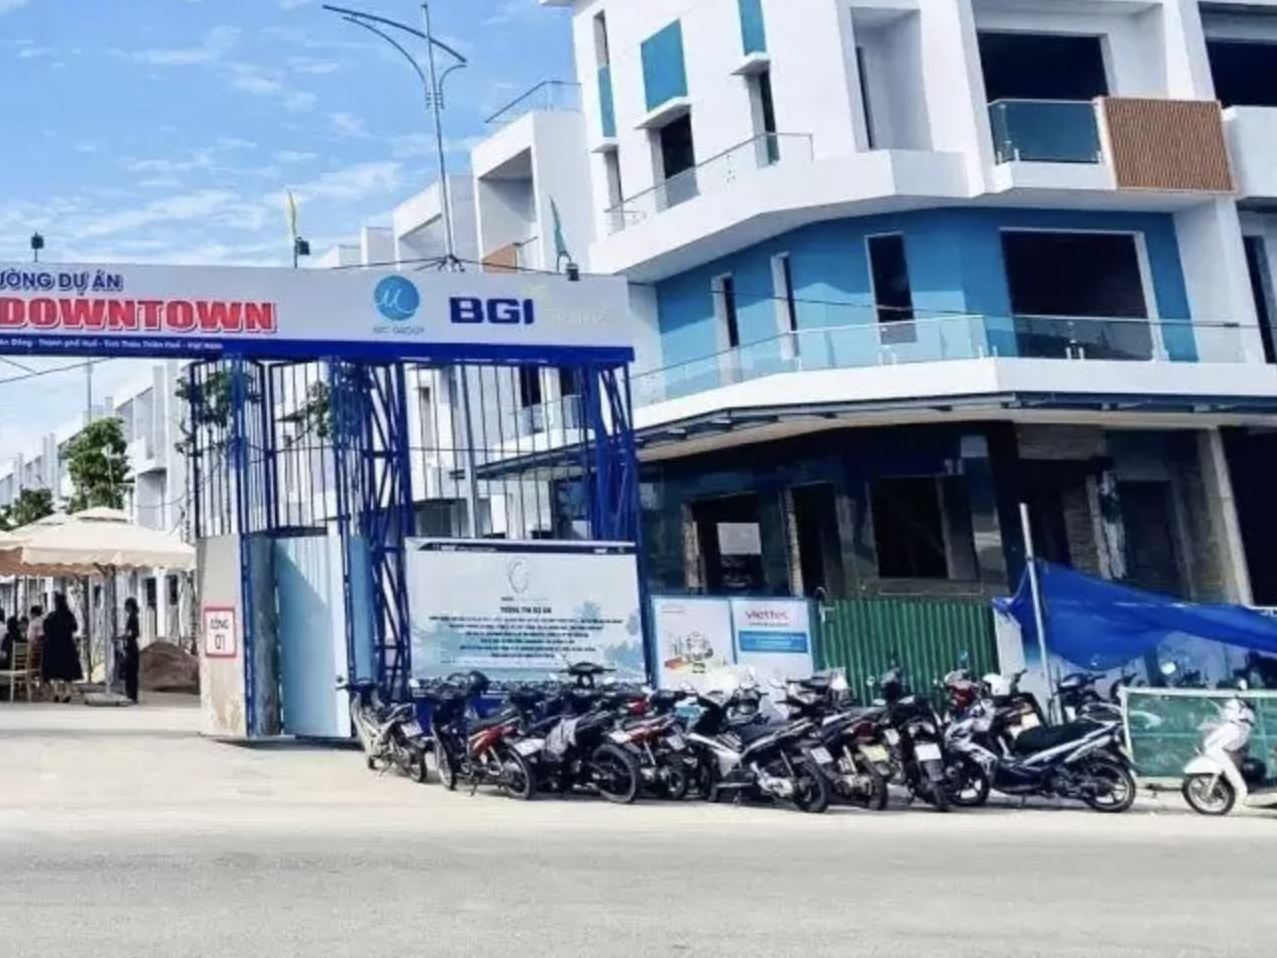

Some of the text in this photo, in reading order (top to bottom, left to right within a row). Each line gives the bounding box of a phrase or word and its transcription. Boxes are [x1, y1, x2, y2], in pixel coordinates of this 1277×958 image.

[58, 271, 89, 296] DỰ
[92, 269, 123, 292] ÁN
[448, 296, 535, 325] BGI
